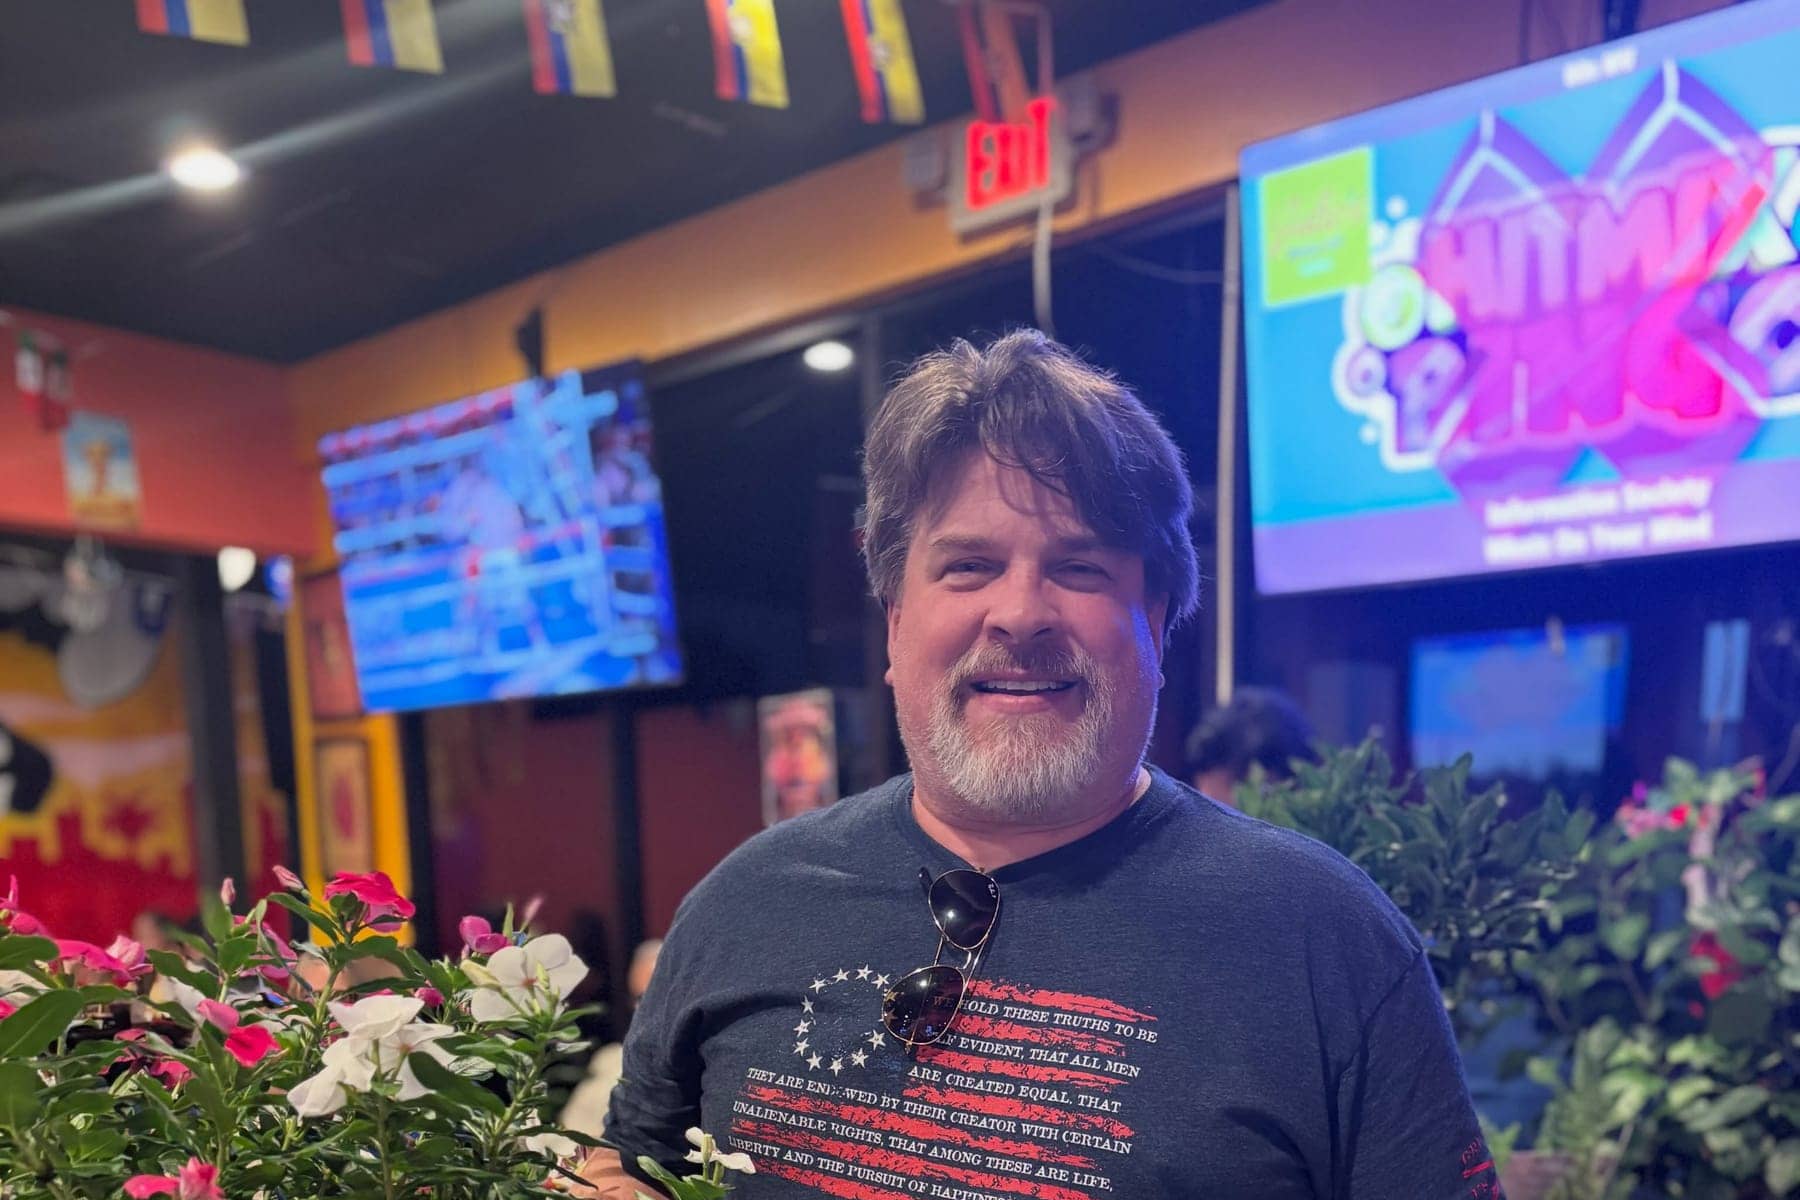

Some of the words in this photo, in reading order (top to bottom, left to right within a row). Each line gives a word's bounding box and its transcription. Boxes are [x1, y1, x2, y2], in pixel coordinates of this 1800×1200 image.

[966, 97, 1053, 211] EXIT
[960, 999, 998, 1015] HOLD
[1003, 1006, 1049, 1023] THESE
[1053, 1013, 1110, 1032] TRUTHS
[1115, 1023, 1134, 1037] TO
[1136, 1029, 1158, 1043] BE
[958, 1037, 1025, 1060] EVIDENT,
[1030, 1049, 1069, 1065] THAT
[1070, 1055, 1101, 1070] ALL
[1104, 1060, 1141, 1077] MEN
[746, 1067, 777, 1083] THEY
[775, 1074, 805, 1089] ARE
[880, 1096, 901, 1109] BY
[903, 1101, 947, 1121] THEIR
[950, 1111, 1017, 1133] CREATOR
[1021, 1123, 1060, 1141] WITH
[1062, 1131, 1133, 1154] CERTAIN
[907, 1066, 942, 1082] ARE
[945, 1073, 1015, 1095] CREATED
[1078, 1094, 1122, 1113] THAT
[728, 1136, 780, 1158] LIBERTY
[783, 1150, 815, 1165] AND
[818, 1157, 845, 1174] THE
[847, 1165, 906, 1189] PURSUIT
[908, 1180, 929, 1193] OF
[733, 1101, 827, 1132] UNALIENABLE
[831, 1122, 885, 1148] RIGHTS,
[888, 1136, 927, 1155] THAT
[928, 1146, 982, 1166] AMONG
[985, 1156, 1033, 1175] THESE
[1035, 1165, 1069, 1181] ARE
[1073, 1172, 1113, 1193] LIFE,
